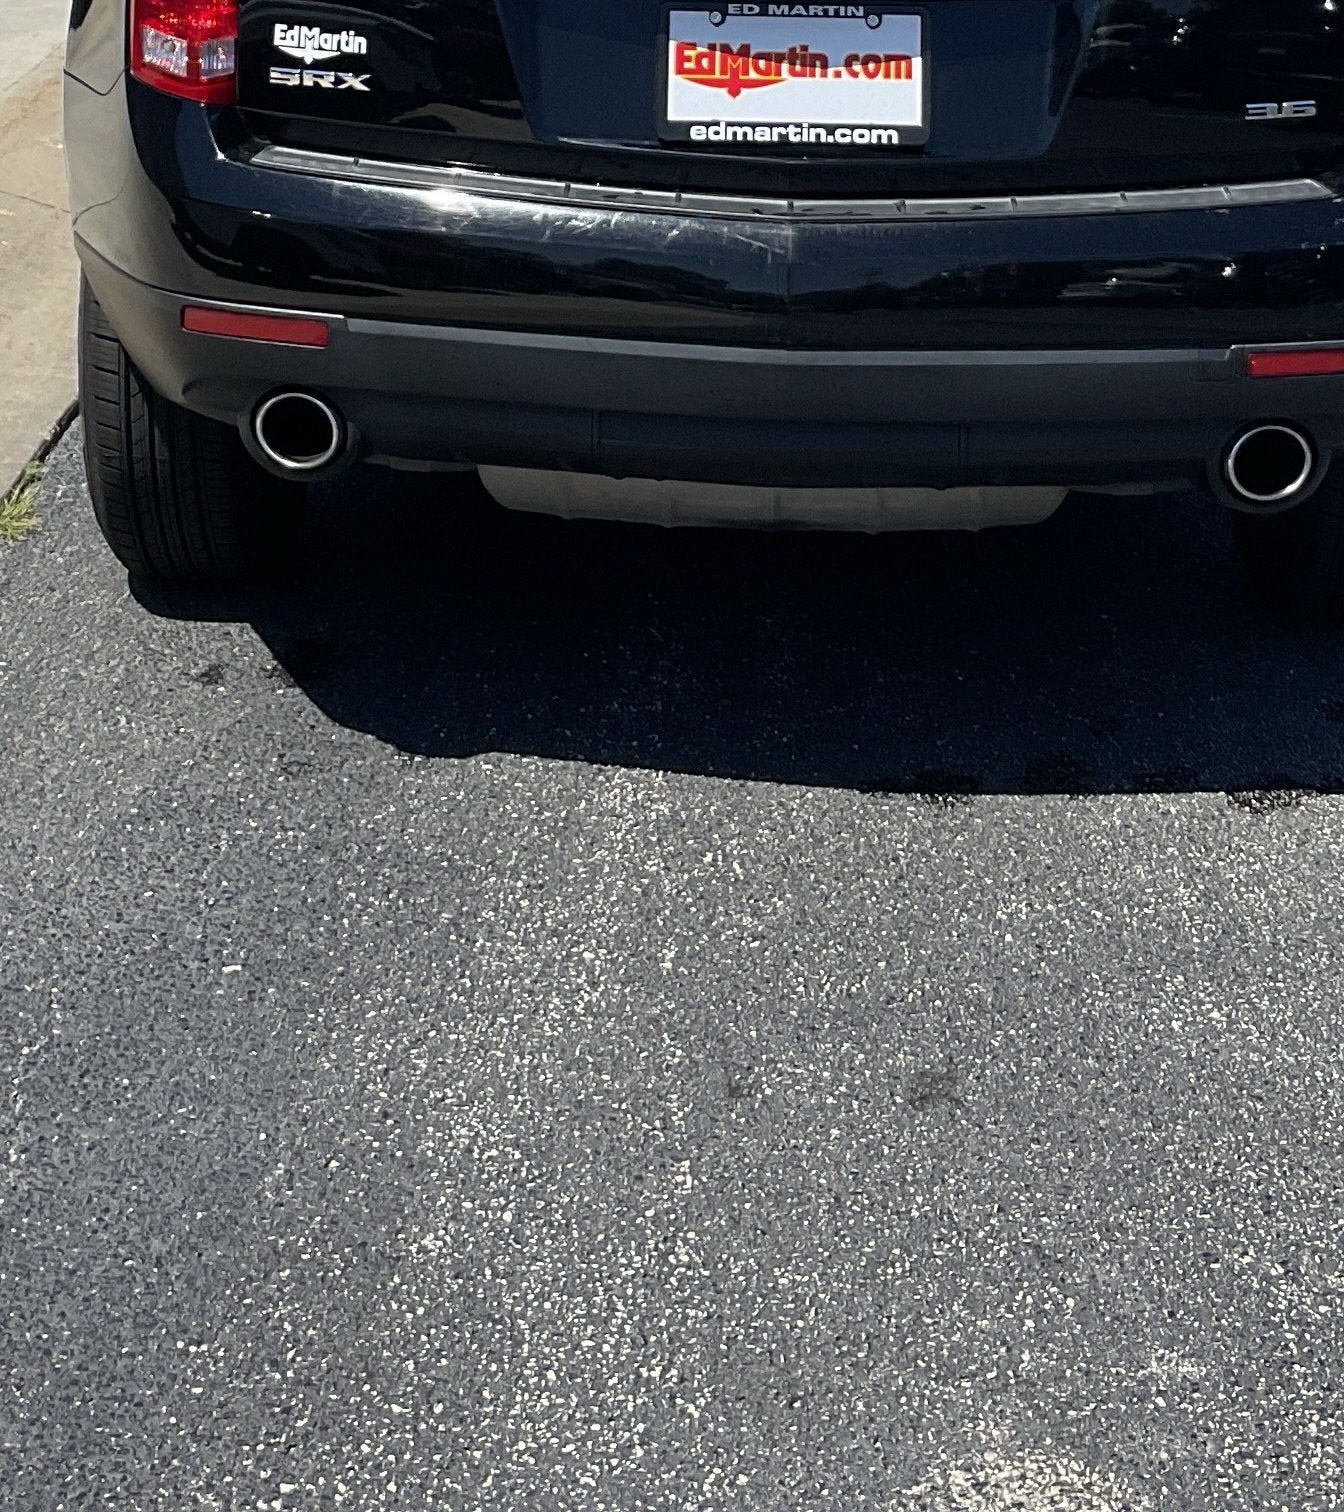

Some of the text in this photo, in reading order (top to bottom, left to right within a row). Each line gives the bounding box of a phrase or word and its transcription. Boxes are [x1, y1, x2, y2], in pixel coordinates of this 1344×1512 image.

[727, 3, 864, 17] ED MARTIN
[274, 23, 367, 55] EdMartin
[674, 41, 913, 81] EdMartin.com
[269, 67, 371, 92] SRX
[689, 120, 899, 145] edmartin.com
